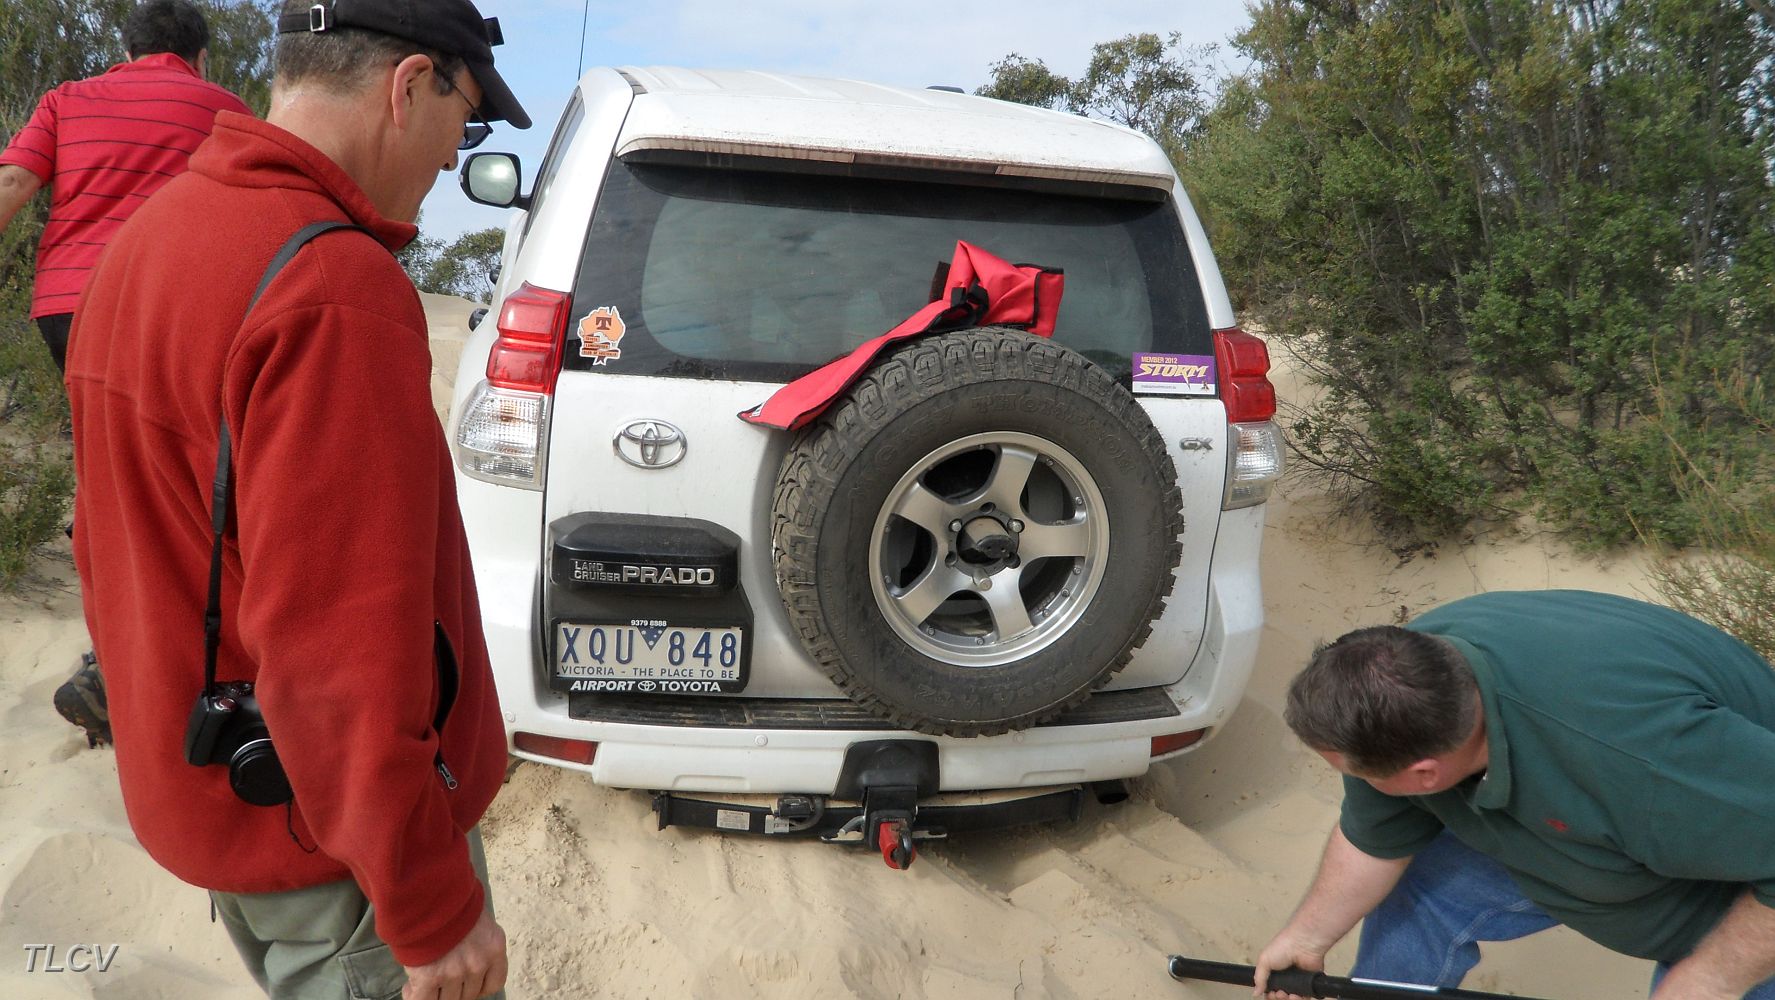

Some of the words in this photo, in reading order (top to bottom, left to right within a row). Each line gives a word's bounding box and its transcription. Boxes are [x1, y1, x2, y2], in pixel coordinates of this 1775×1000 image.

[595, 316, 612, 331] T
[1141, 356, 1164, 364] MEMBER
[1133, 363, 1209, 385] STORM
[574, 561, 604, 571] LAND
[574, 570, 621, 582] CRUISER
[622, 565, 715, 585] PRADO
[630, 619, 649, 627] 9379
[561, 627, 634, 665] XQU
[667, 630, 737, 668] 848
[561, 665, 615, 676] VICTORIA
[632, 667, 654, 677] THE
[660, 668, 694, 678] PLACE
[700, 669, 714, 679] TO
[721, 670, 734, 679] BE
[570, 680, 636, 691] AIRPORT
[659, 681, 722, 692] TOYOTA
